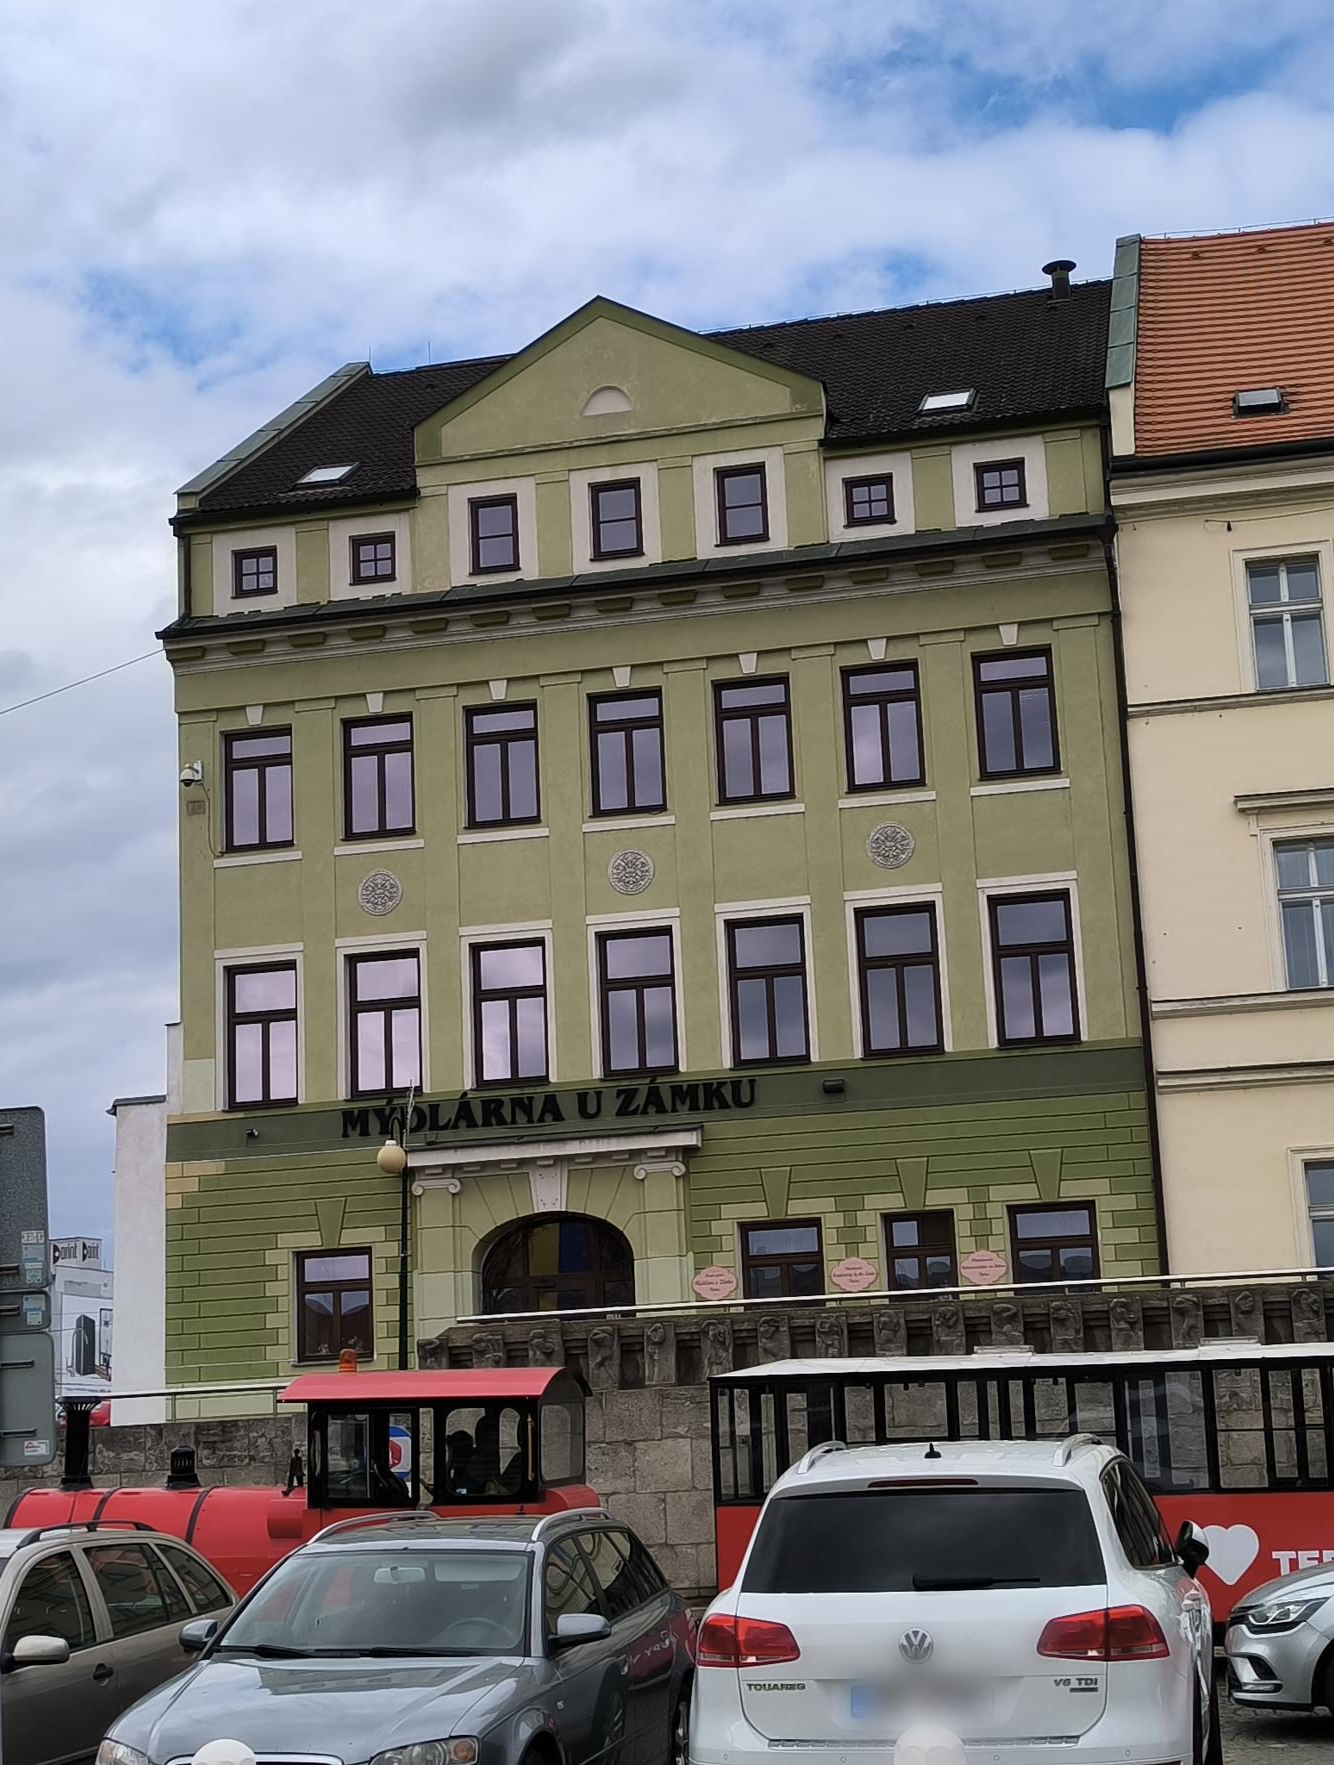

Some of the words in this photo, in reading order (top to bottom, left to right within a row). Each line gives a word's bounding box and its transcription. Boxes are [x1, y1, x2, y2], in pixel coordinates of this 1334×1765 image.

[341, 1091, 565, 1138] MÝDLÁRNA
[577, 1090, 603, 1119] U
[615, 1077, 757, 1117] ZÁMKU
[747, 1683, 805, 1691] TOUAREG
[1054, 1678, 1071, 1687] V6
[1076, 1677, 1098, 1686] TDI
